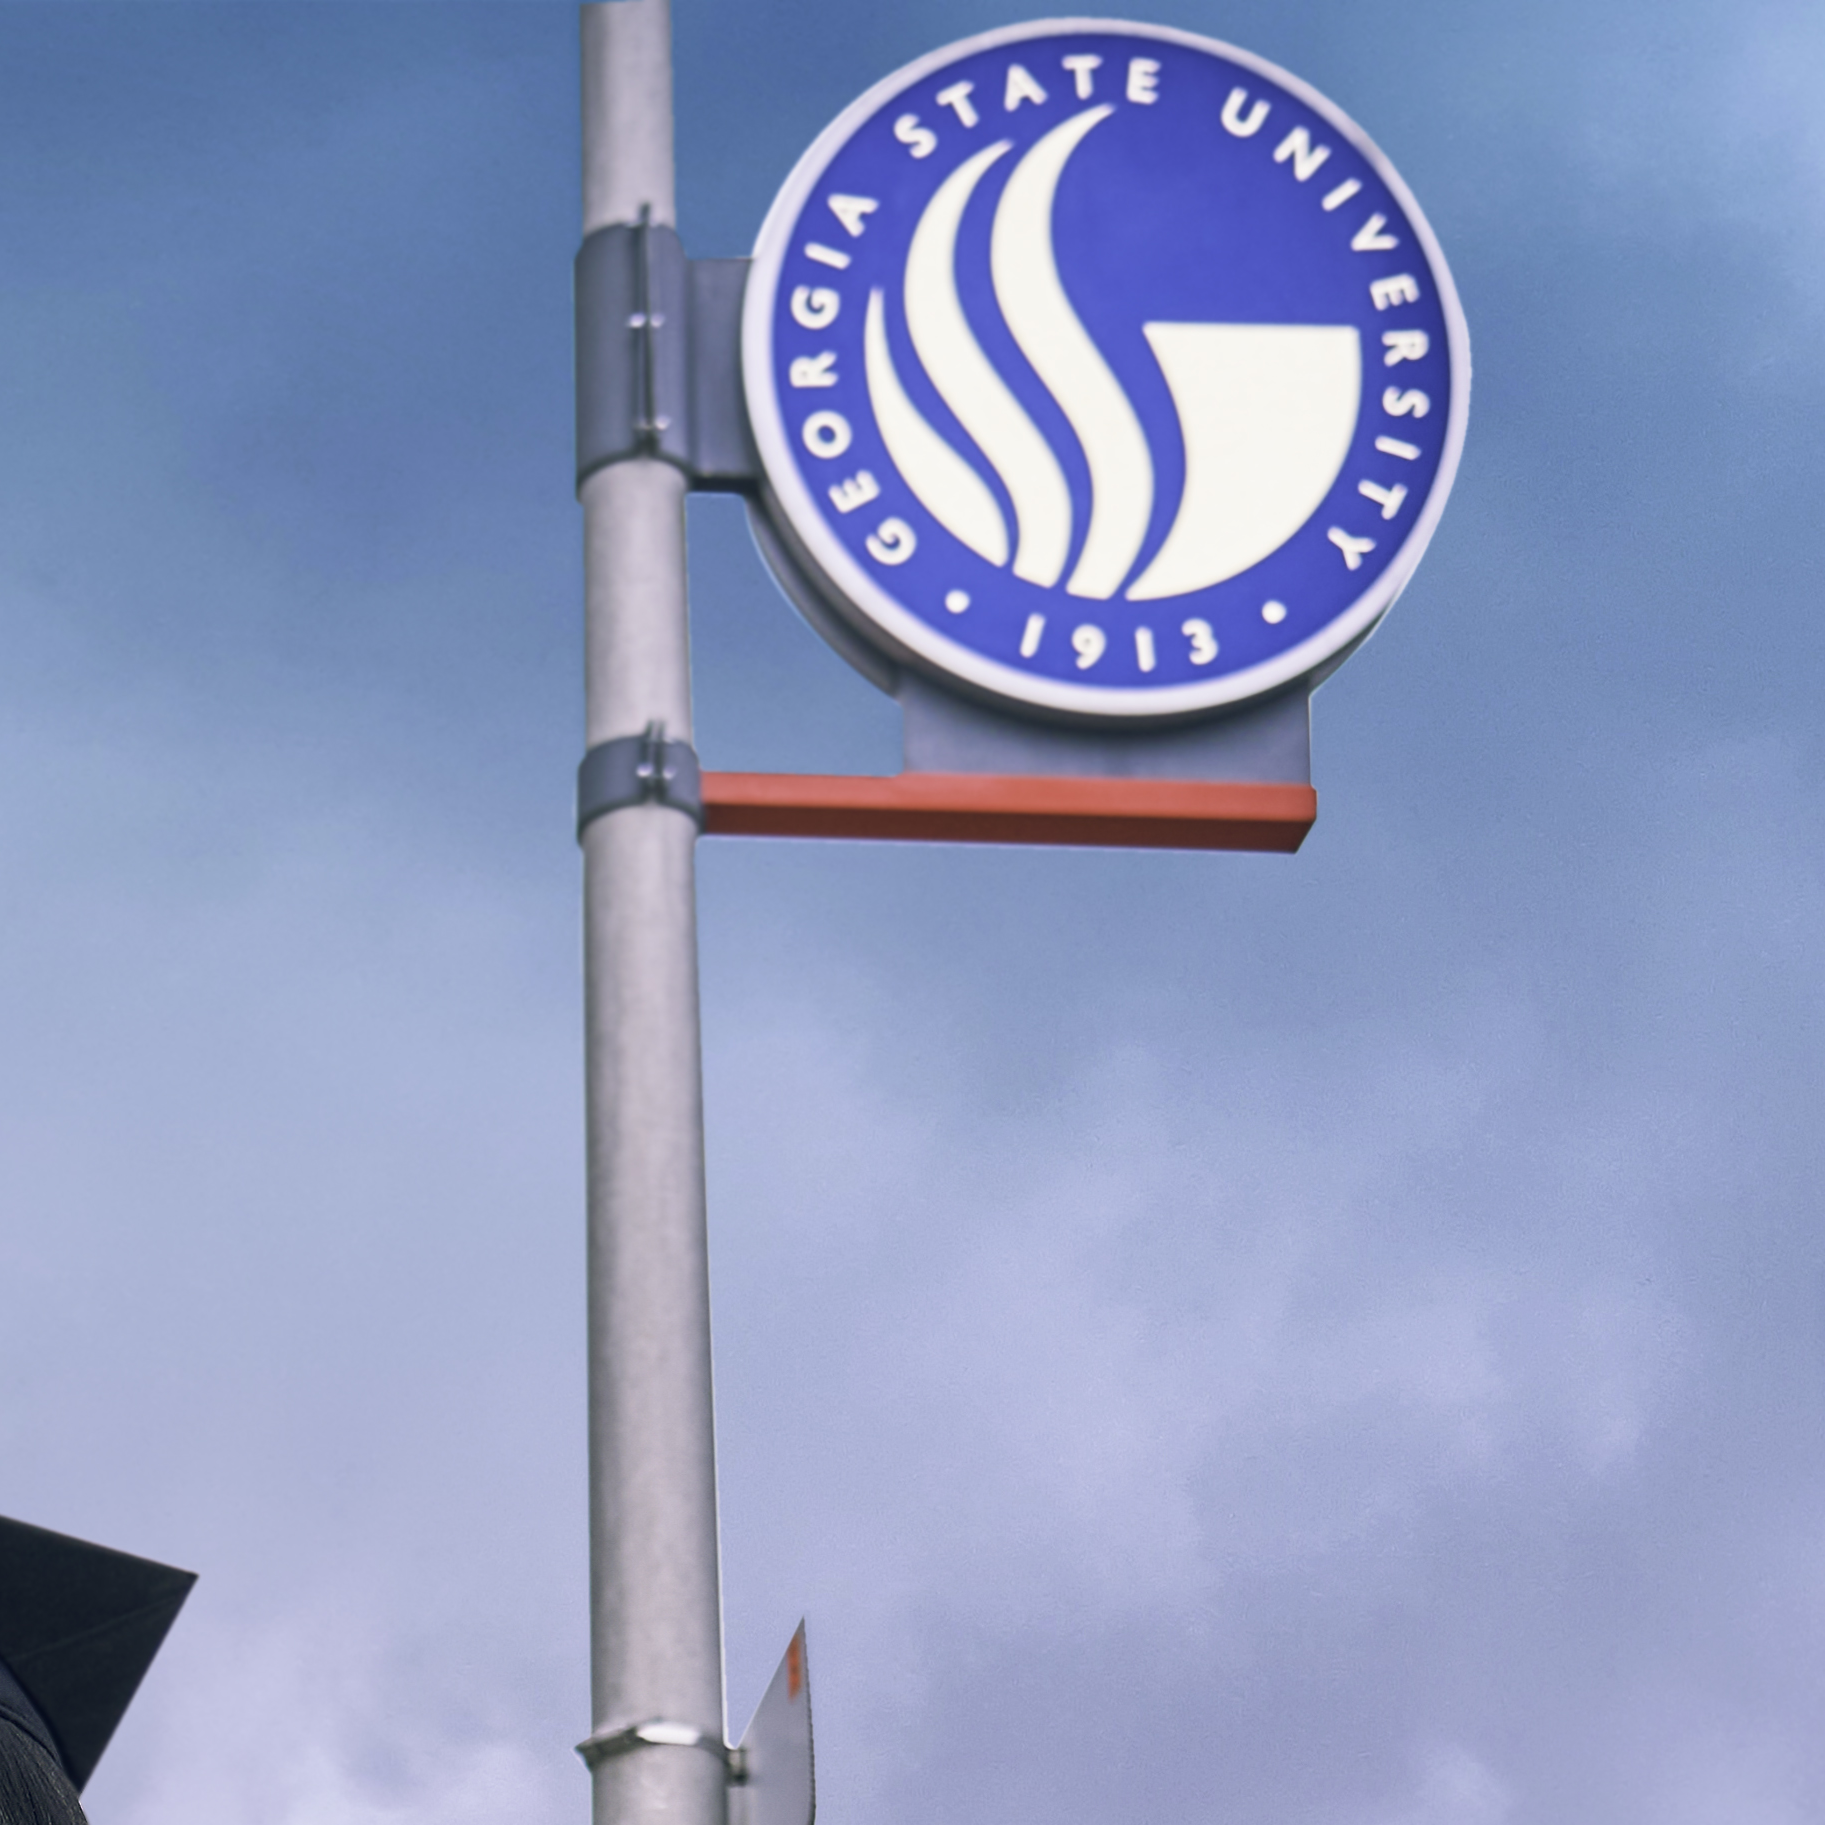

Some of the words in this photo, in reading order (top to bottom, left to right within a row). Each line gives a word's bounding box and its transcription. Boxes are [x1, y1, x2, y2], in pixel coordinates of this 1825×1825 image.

[790, 191, 916, 566] GEORGIA
[894, 54, 1162, 159] STATE
[1220, 86, 1430, 571] UNIVERSITY
[1020, 612, 1219, 672] 1913
